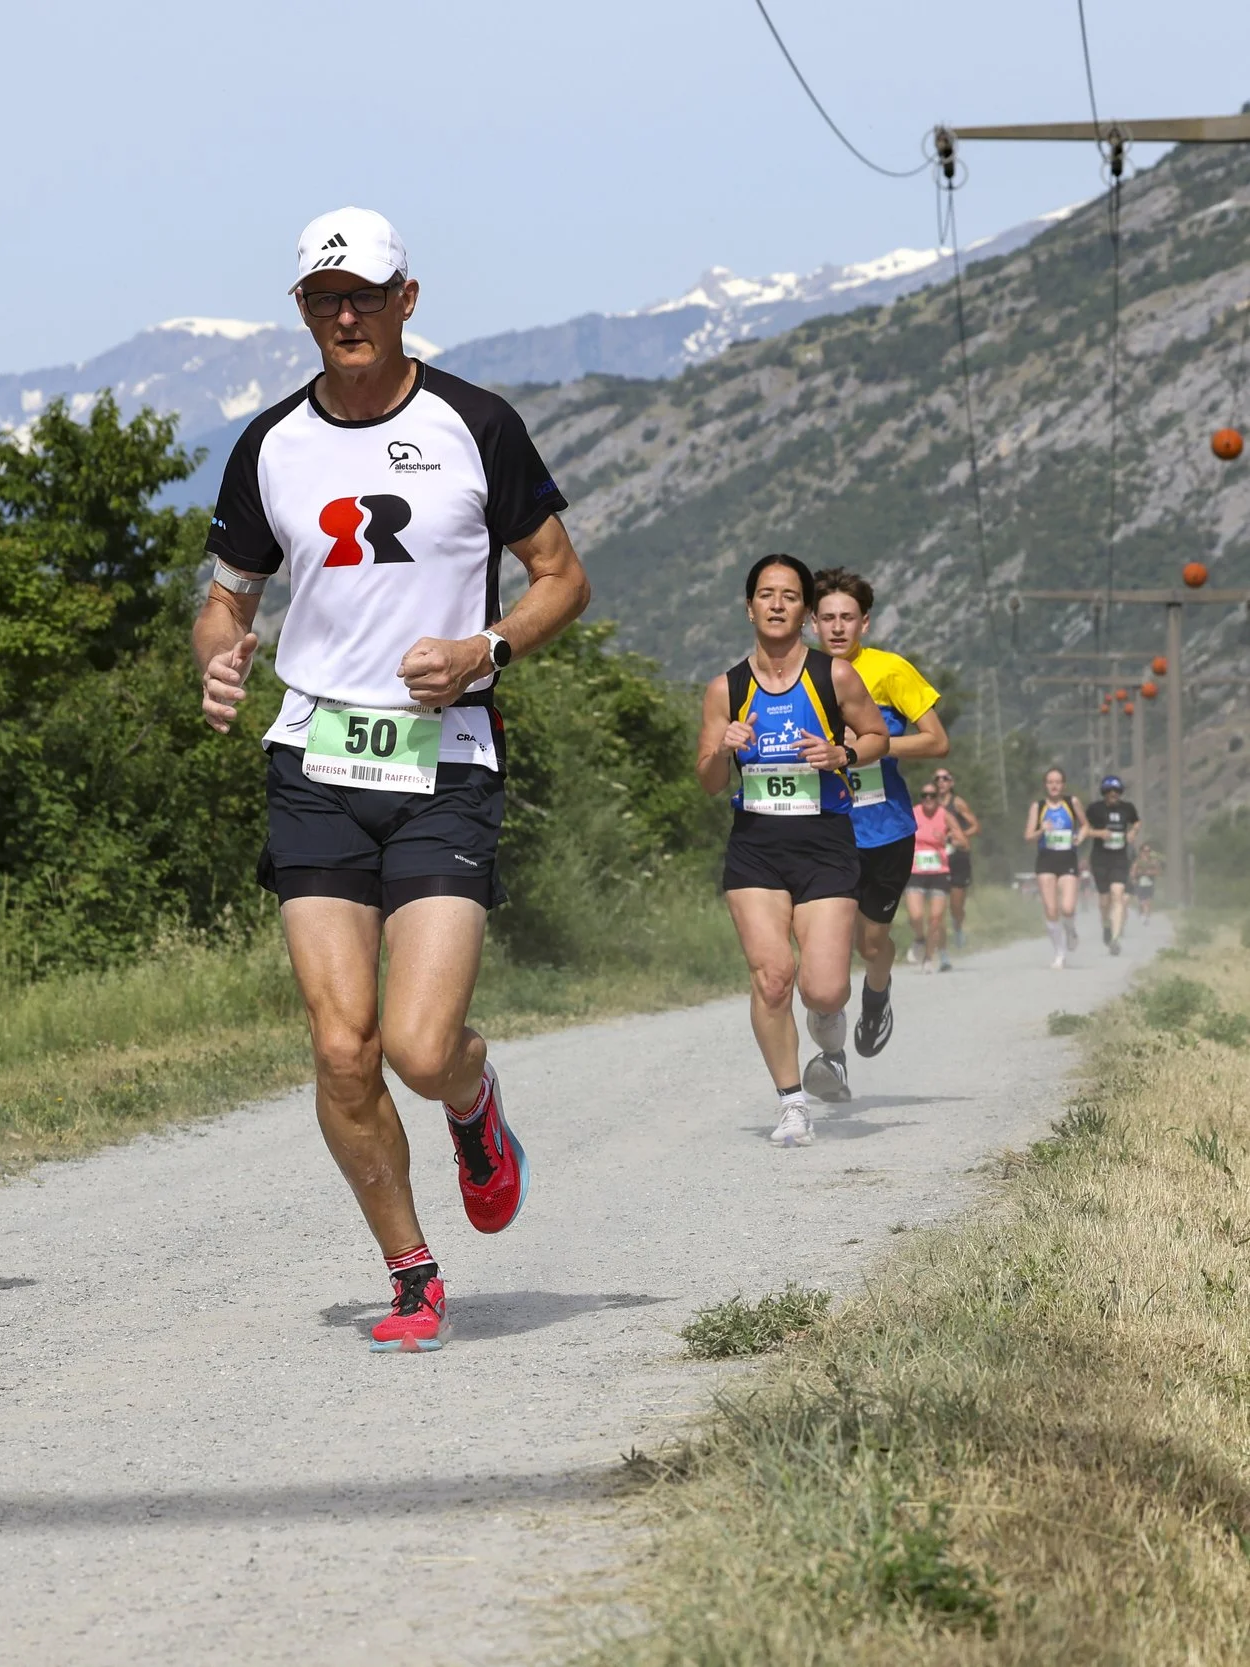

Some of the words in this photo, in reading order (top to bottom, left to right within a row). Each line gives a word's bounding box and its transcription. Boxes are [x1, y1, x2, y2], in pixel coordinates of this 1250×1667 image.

[395, 462, 441, 472] aletschsport
[345, 715, 398, 757] 50
[762, 737, 775, 745] TV
[306, 763, 347, 775] RAIFFEISEN
[384, 773, 431, 784] RAIFFEISEN
[767, 776, 796, 797] 65
